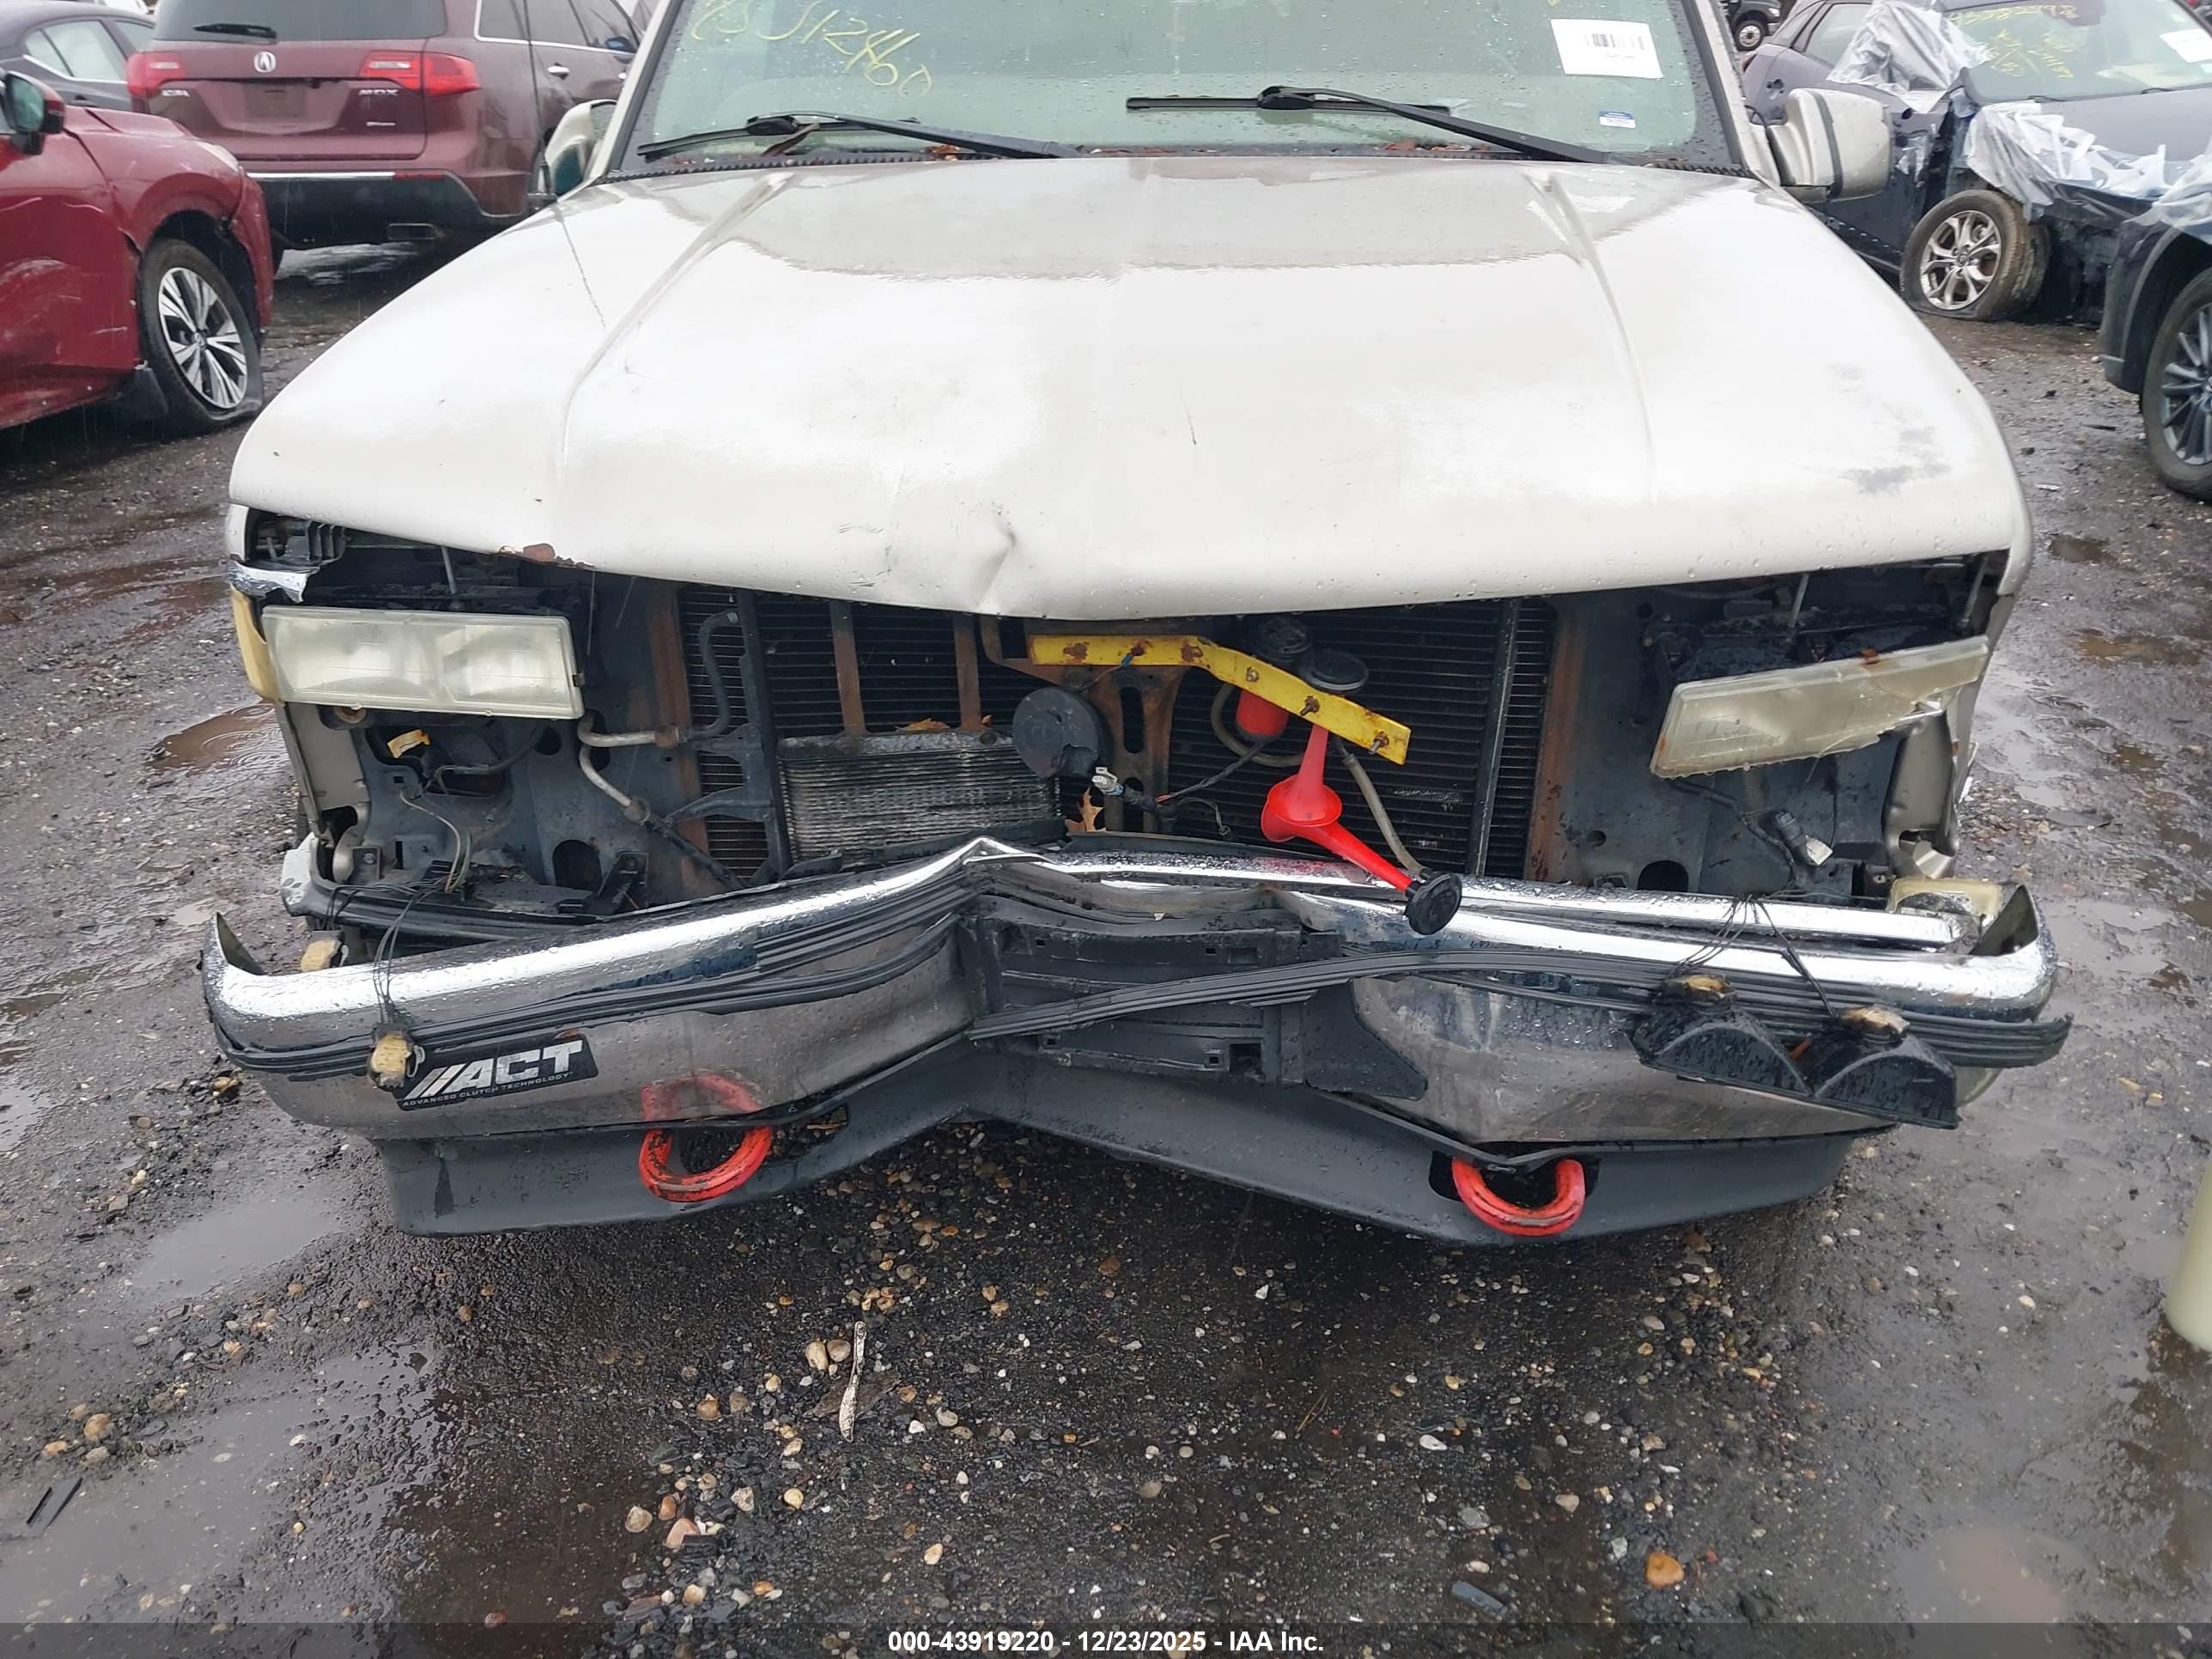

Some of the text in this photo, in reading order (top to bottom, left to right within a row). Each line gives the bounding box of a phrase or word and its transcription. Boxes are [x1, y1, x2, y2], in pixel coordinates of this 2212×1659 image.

[402, 1073, 569, 1107] ADVANCED CLUTCH TECHNOLOGY
